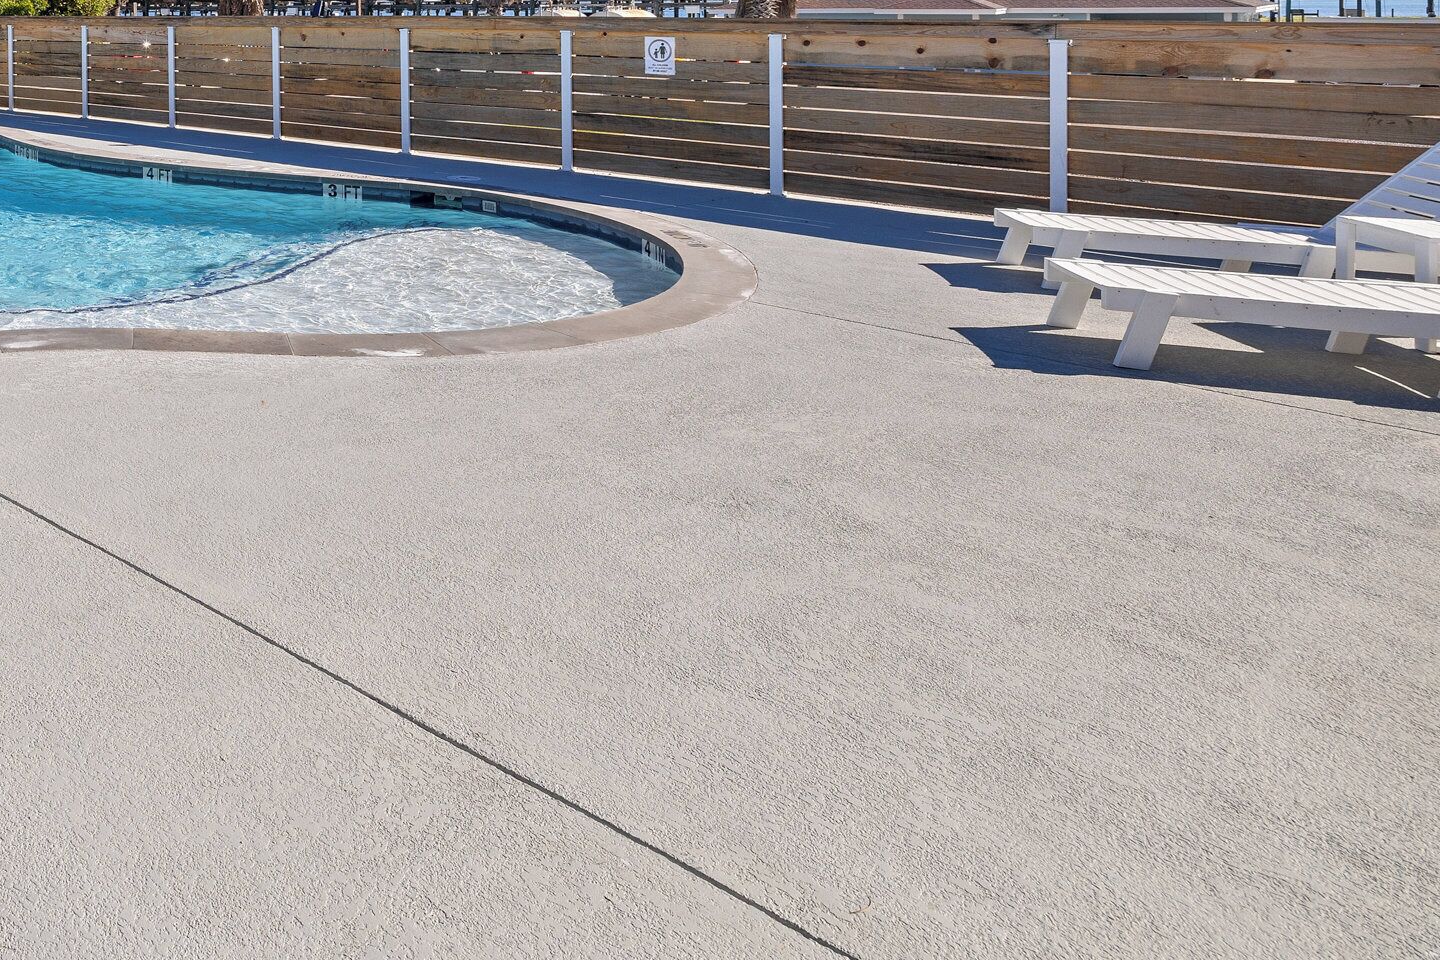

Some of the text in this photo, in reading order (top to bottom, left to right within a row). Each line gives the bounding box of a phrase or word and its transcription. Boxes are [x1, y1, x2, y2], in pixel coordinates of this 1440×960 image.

[147, 167, 170, 182] 4 FT
[328, 184, 361, 200] 3 FT
[645, 241, 651, 257] 4
